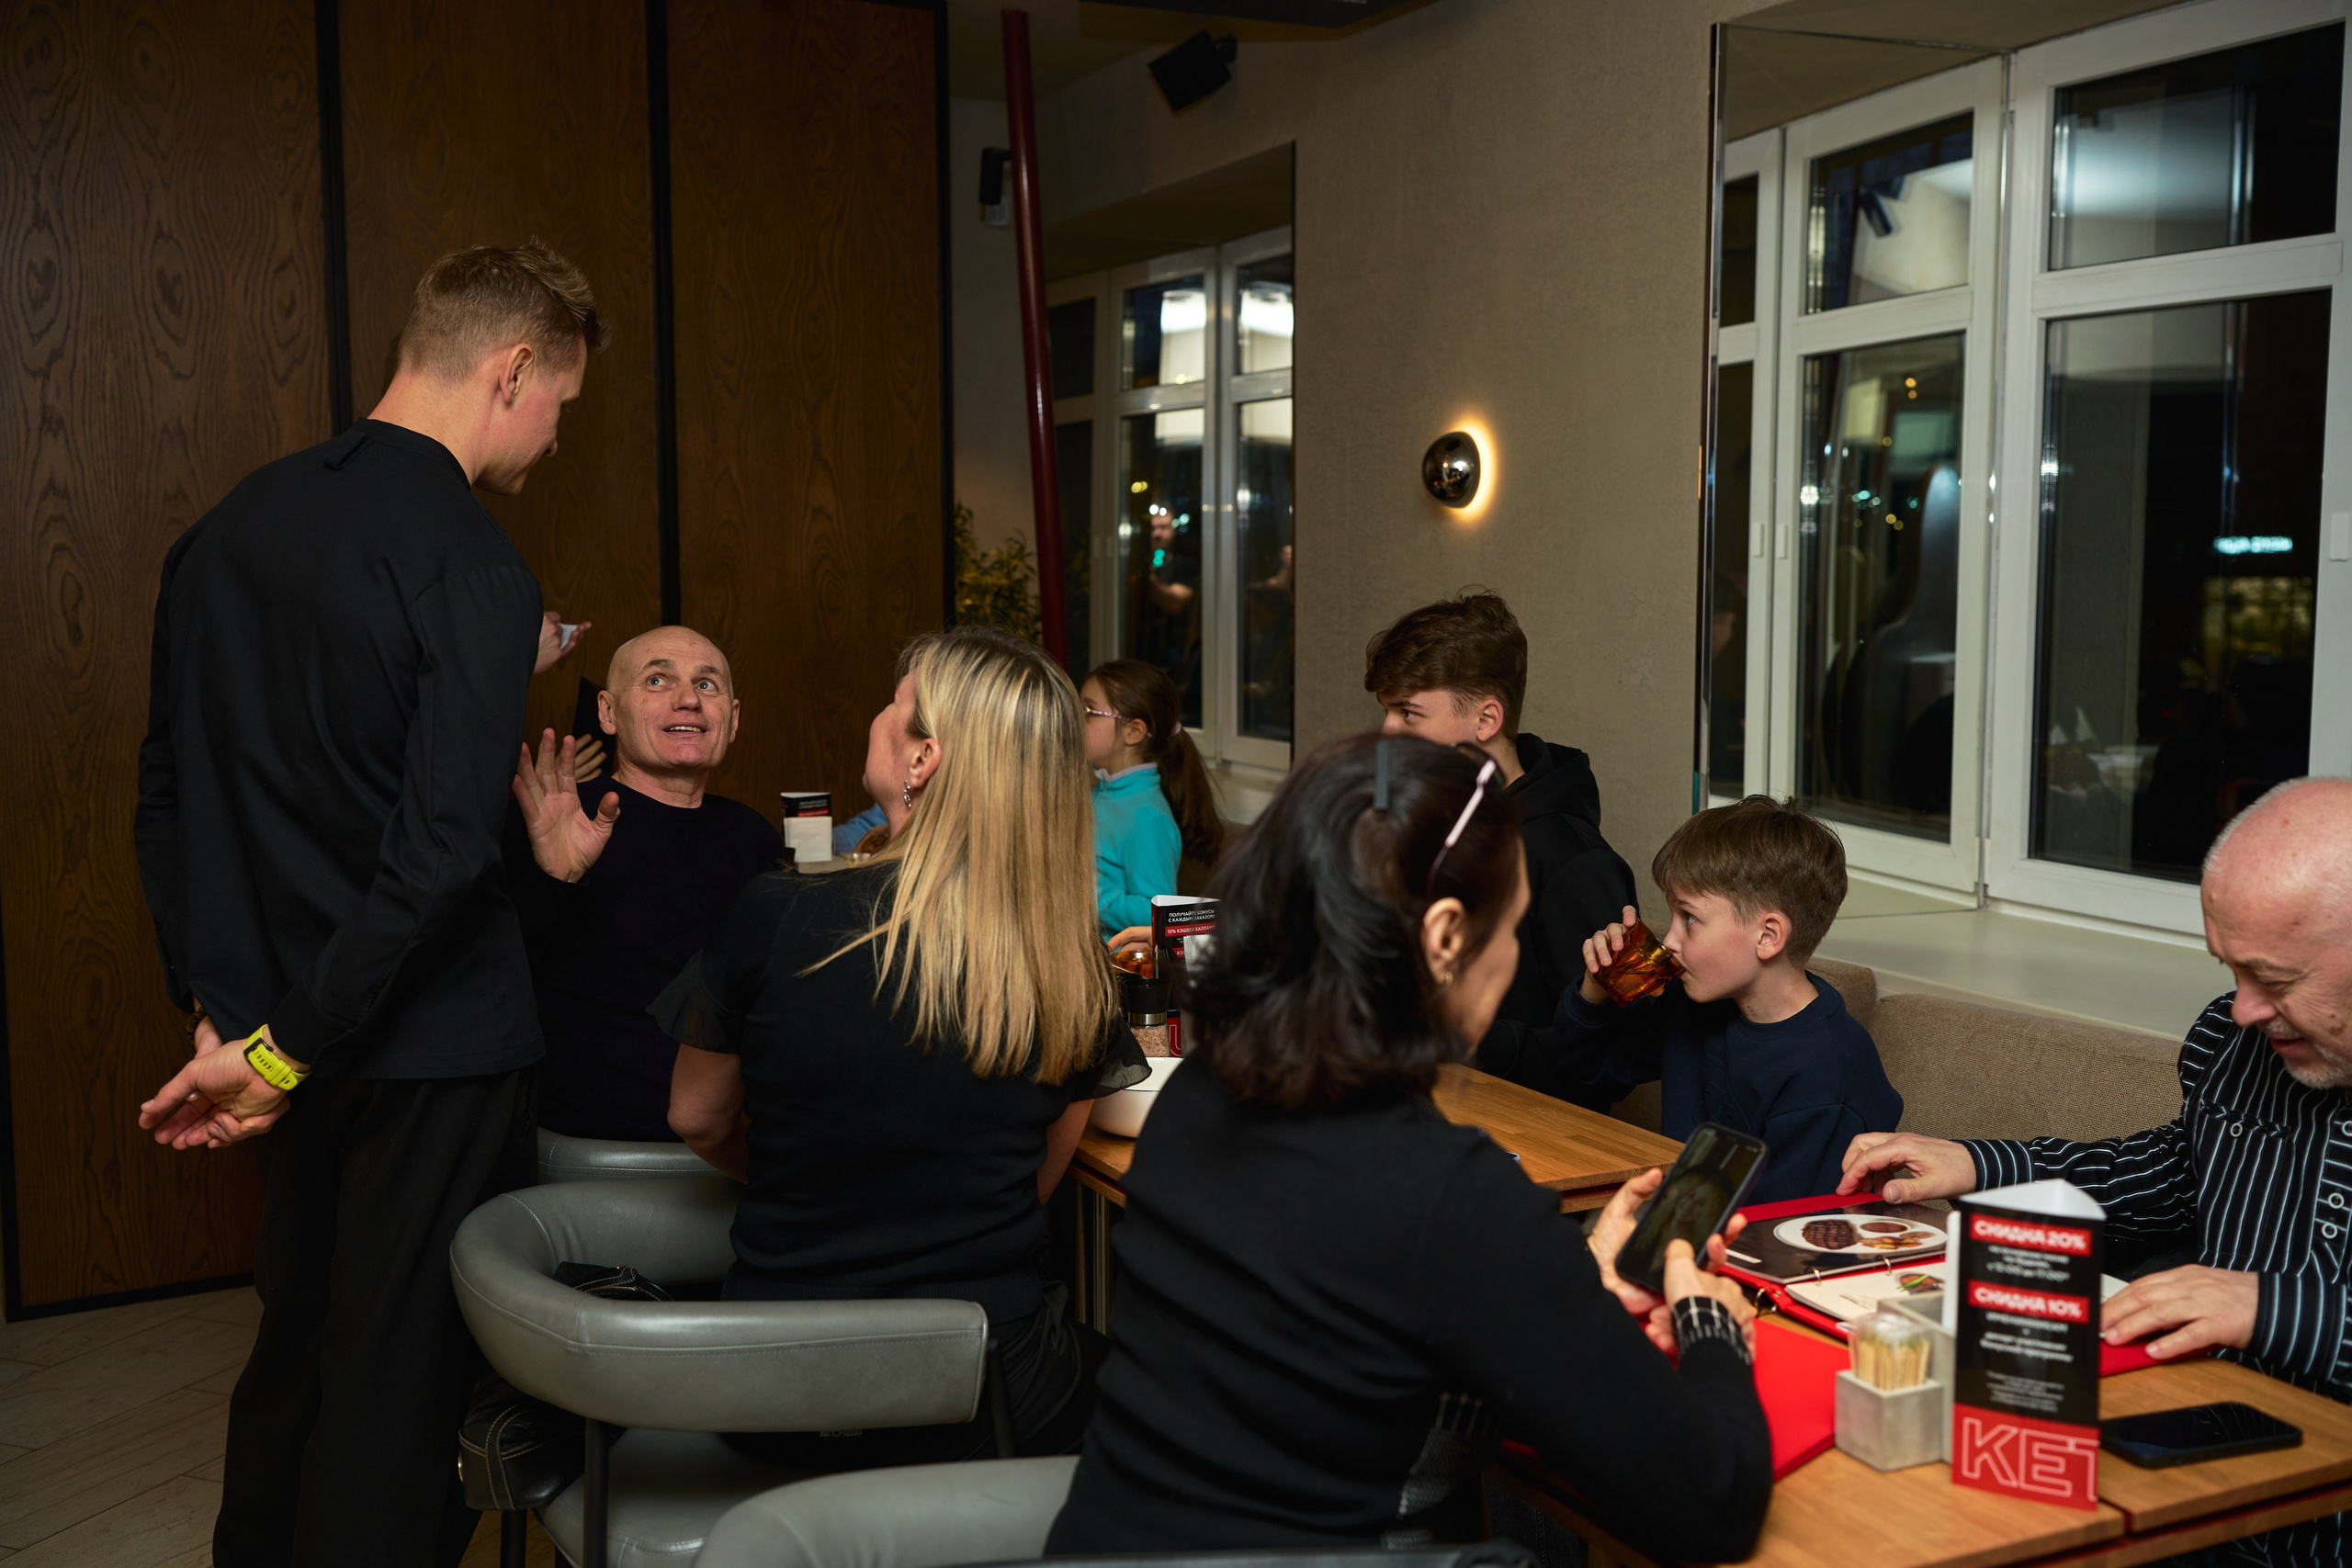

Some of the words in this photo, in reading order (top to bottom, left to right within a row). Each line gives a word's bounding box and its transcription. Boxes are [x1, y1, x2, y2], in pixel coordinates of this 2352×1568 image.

[1974, 1220, 2047, 1246] СКИДКА
[2048, 1232, 2087, 1250] 20%
[1974, 1287, 2047, 1313] СКИДКА
[2048, 1299, 2083, 1318] 10%
